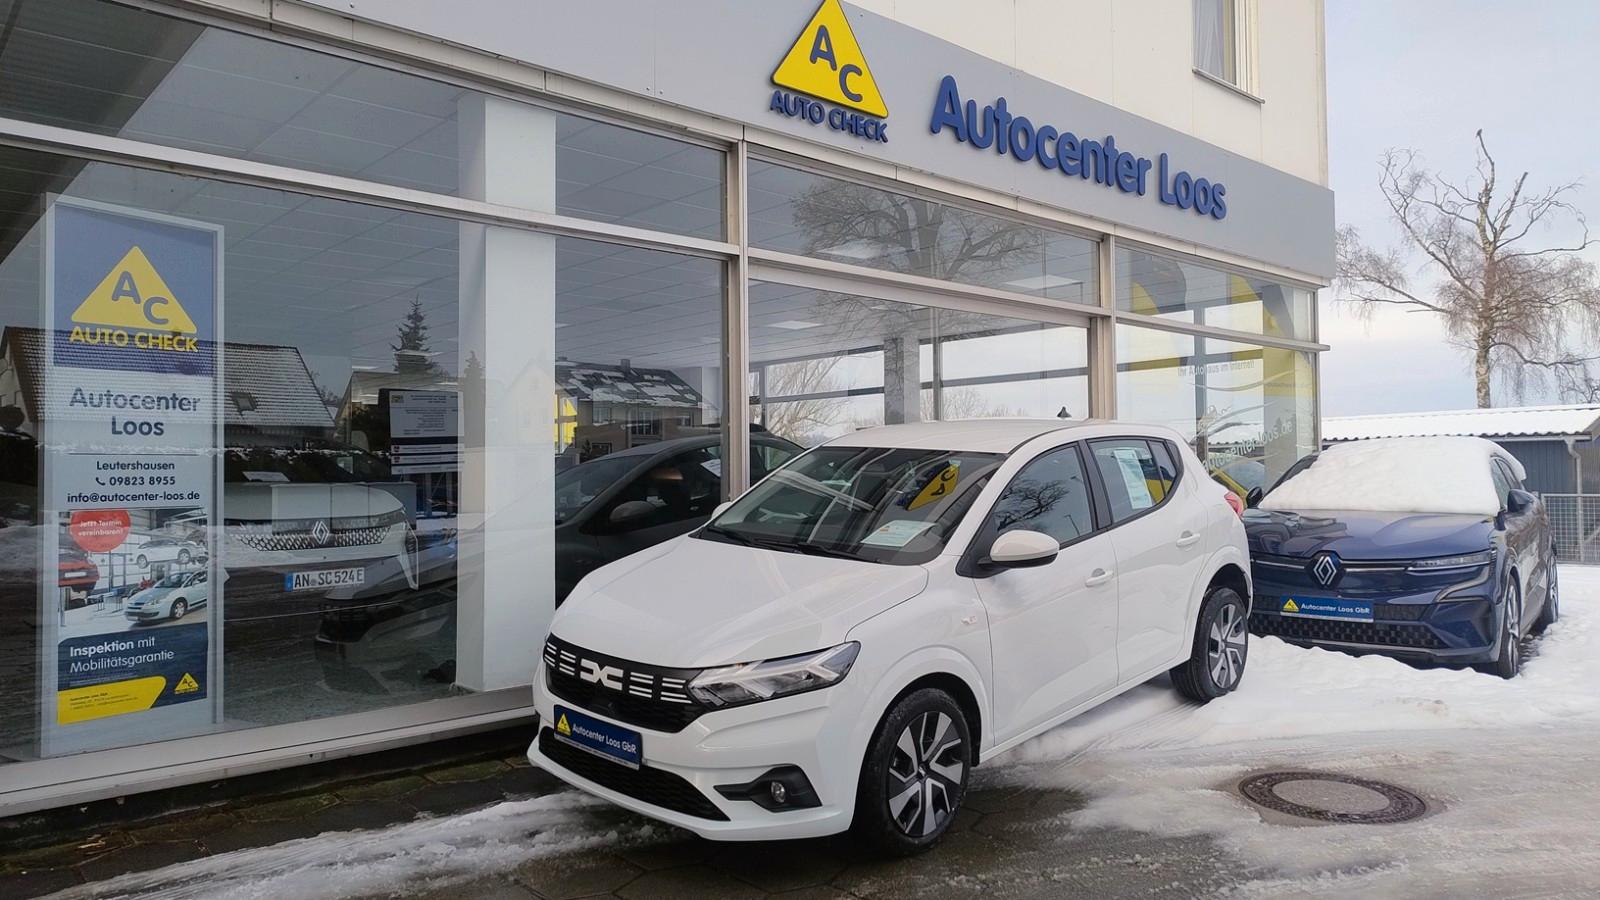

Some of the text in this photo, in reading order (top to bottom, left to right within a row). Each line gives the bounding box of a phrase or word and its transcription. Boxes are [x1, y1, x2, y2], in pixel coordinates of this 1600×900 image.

[769, 89, 889, 143] AUTO CHECK
[930, 75, 1227, 220] Autocenter Loos
[69, 326, 199, 353] AUTO CHECK
[69, 386, 201, 413] Autocenter
[111, 416, 165, 437] Loos
[96, 460, 175, 471] Leutershausen
[109, 475, 176, 486] 09823 8955
[67, 490, 201, 503] info@autocenter-loos.de
[294, 573, 310, 588] AN
[318, 571, 333, 586] SC
[1300, 603, 1371, 615] Autocenter Loos GbR
[70, 636, 155, 657] Inspektion mit
[70, 649, 175, 674] Mobilitätsgarantie
[572, 723, 637, 754] Autocenter Loos GbR
